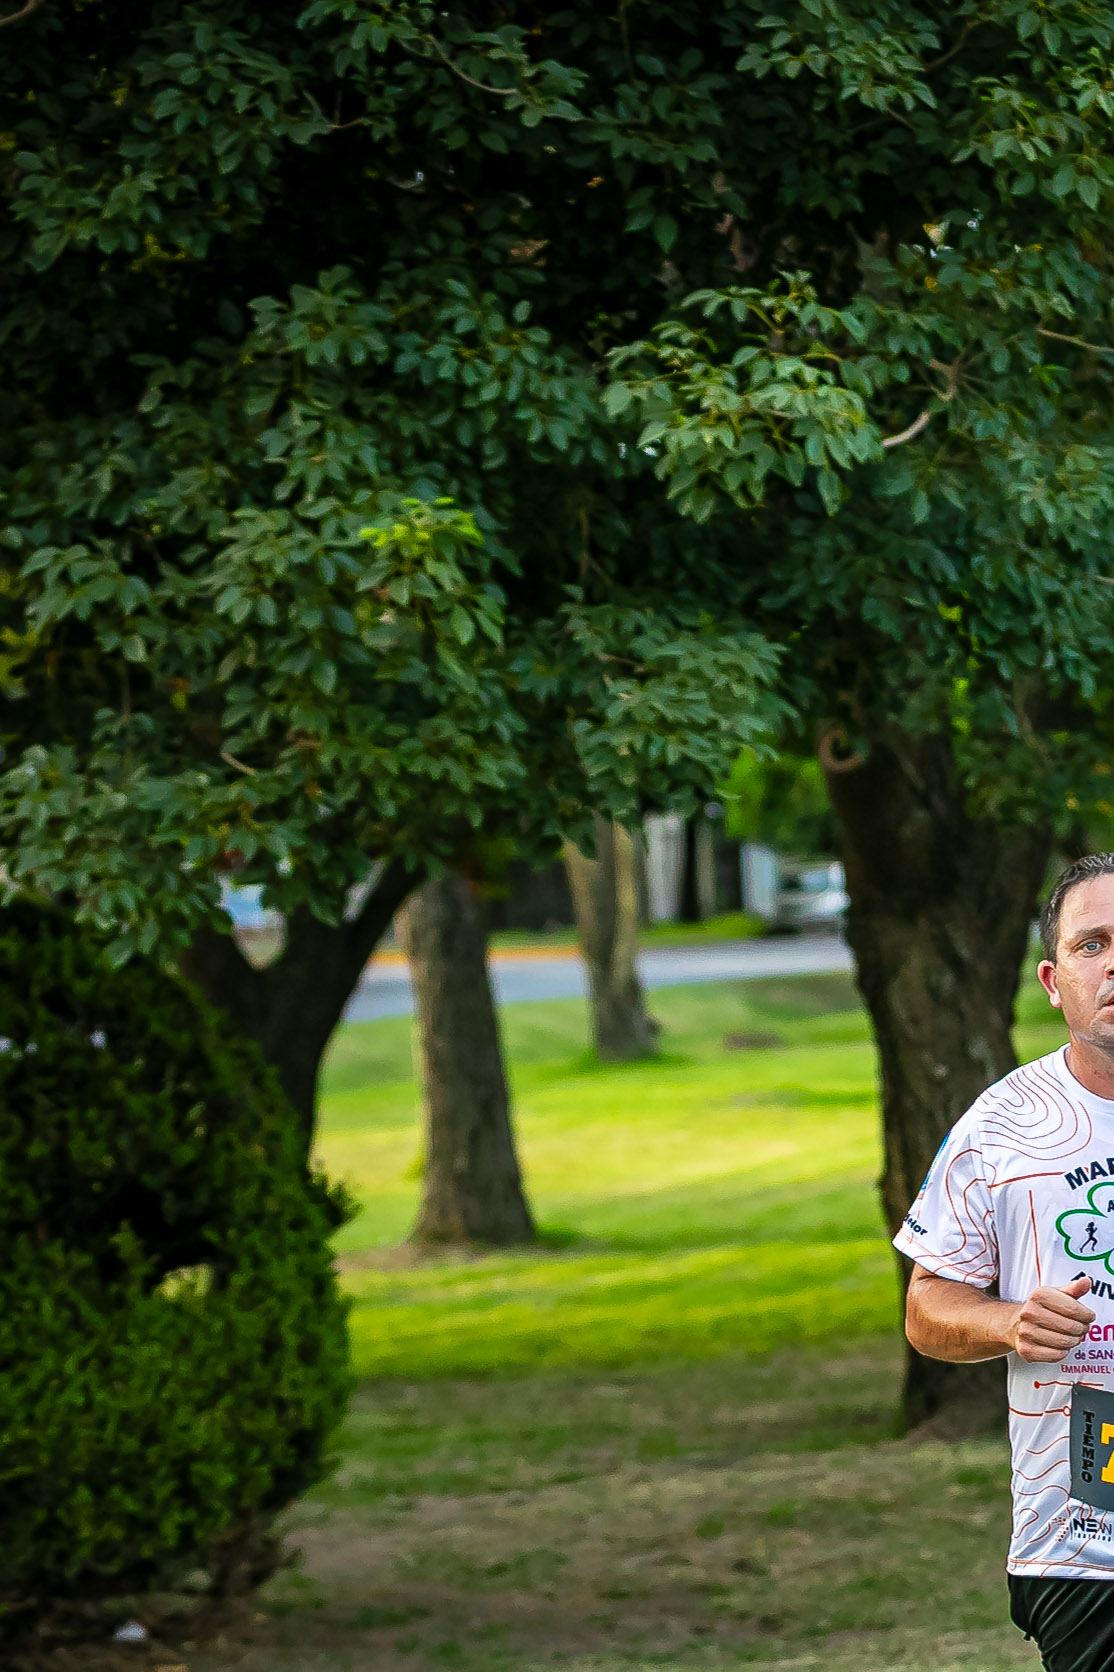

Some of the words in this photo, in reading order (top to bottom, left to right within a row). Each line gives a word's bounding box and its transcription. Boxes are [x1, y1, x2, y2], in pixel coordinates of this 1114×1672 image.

[1074, 1349, 1087, 1361] de
[1060, 1364, 1111, 1375] EMMANUEL
[1081, 1410, 1095, 1484] TIEMPO
